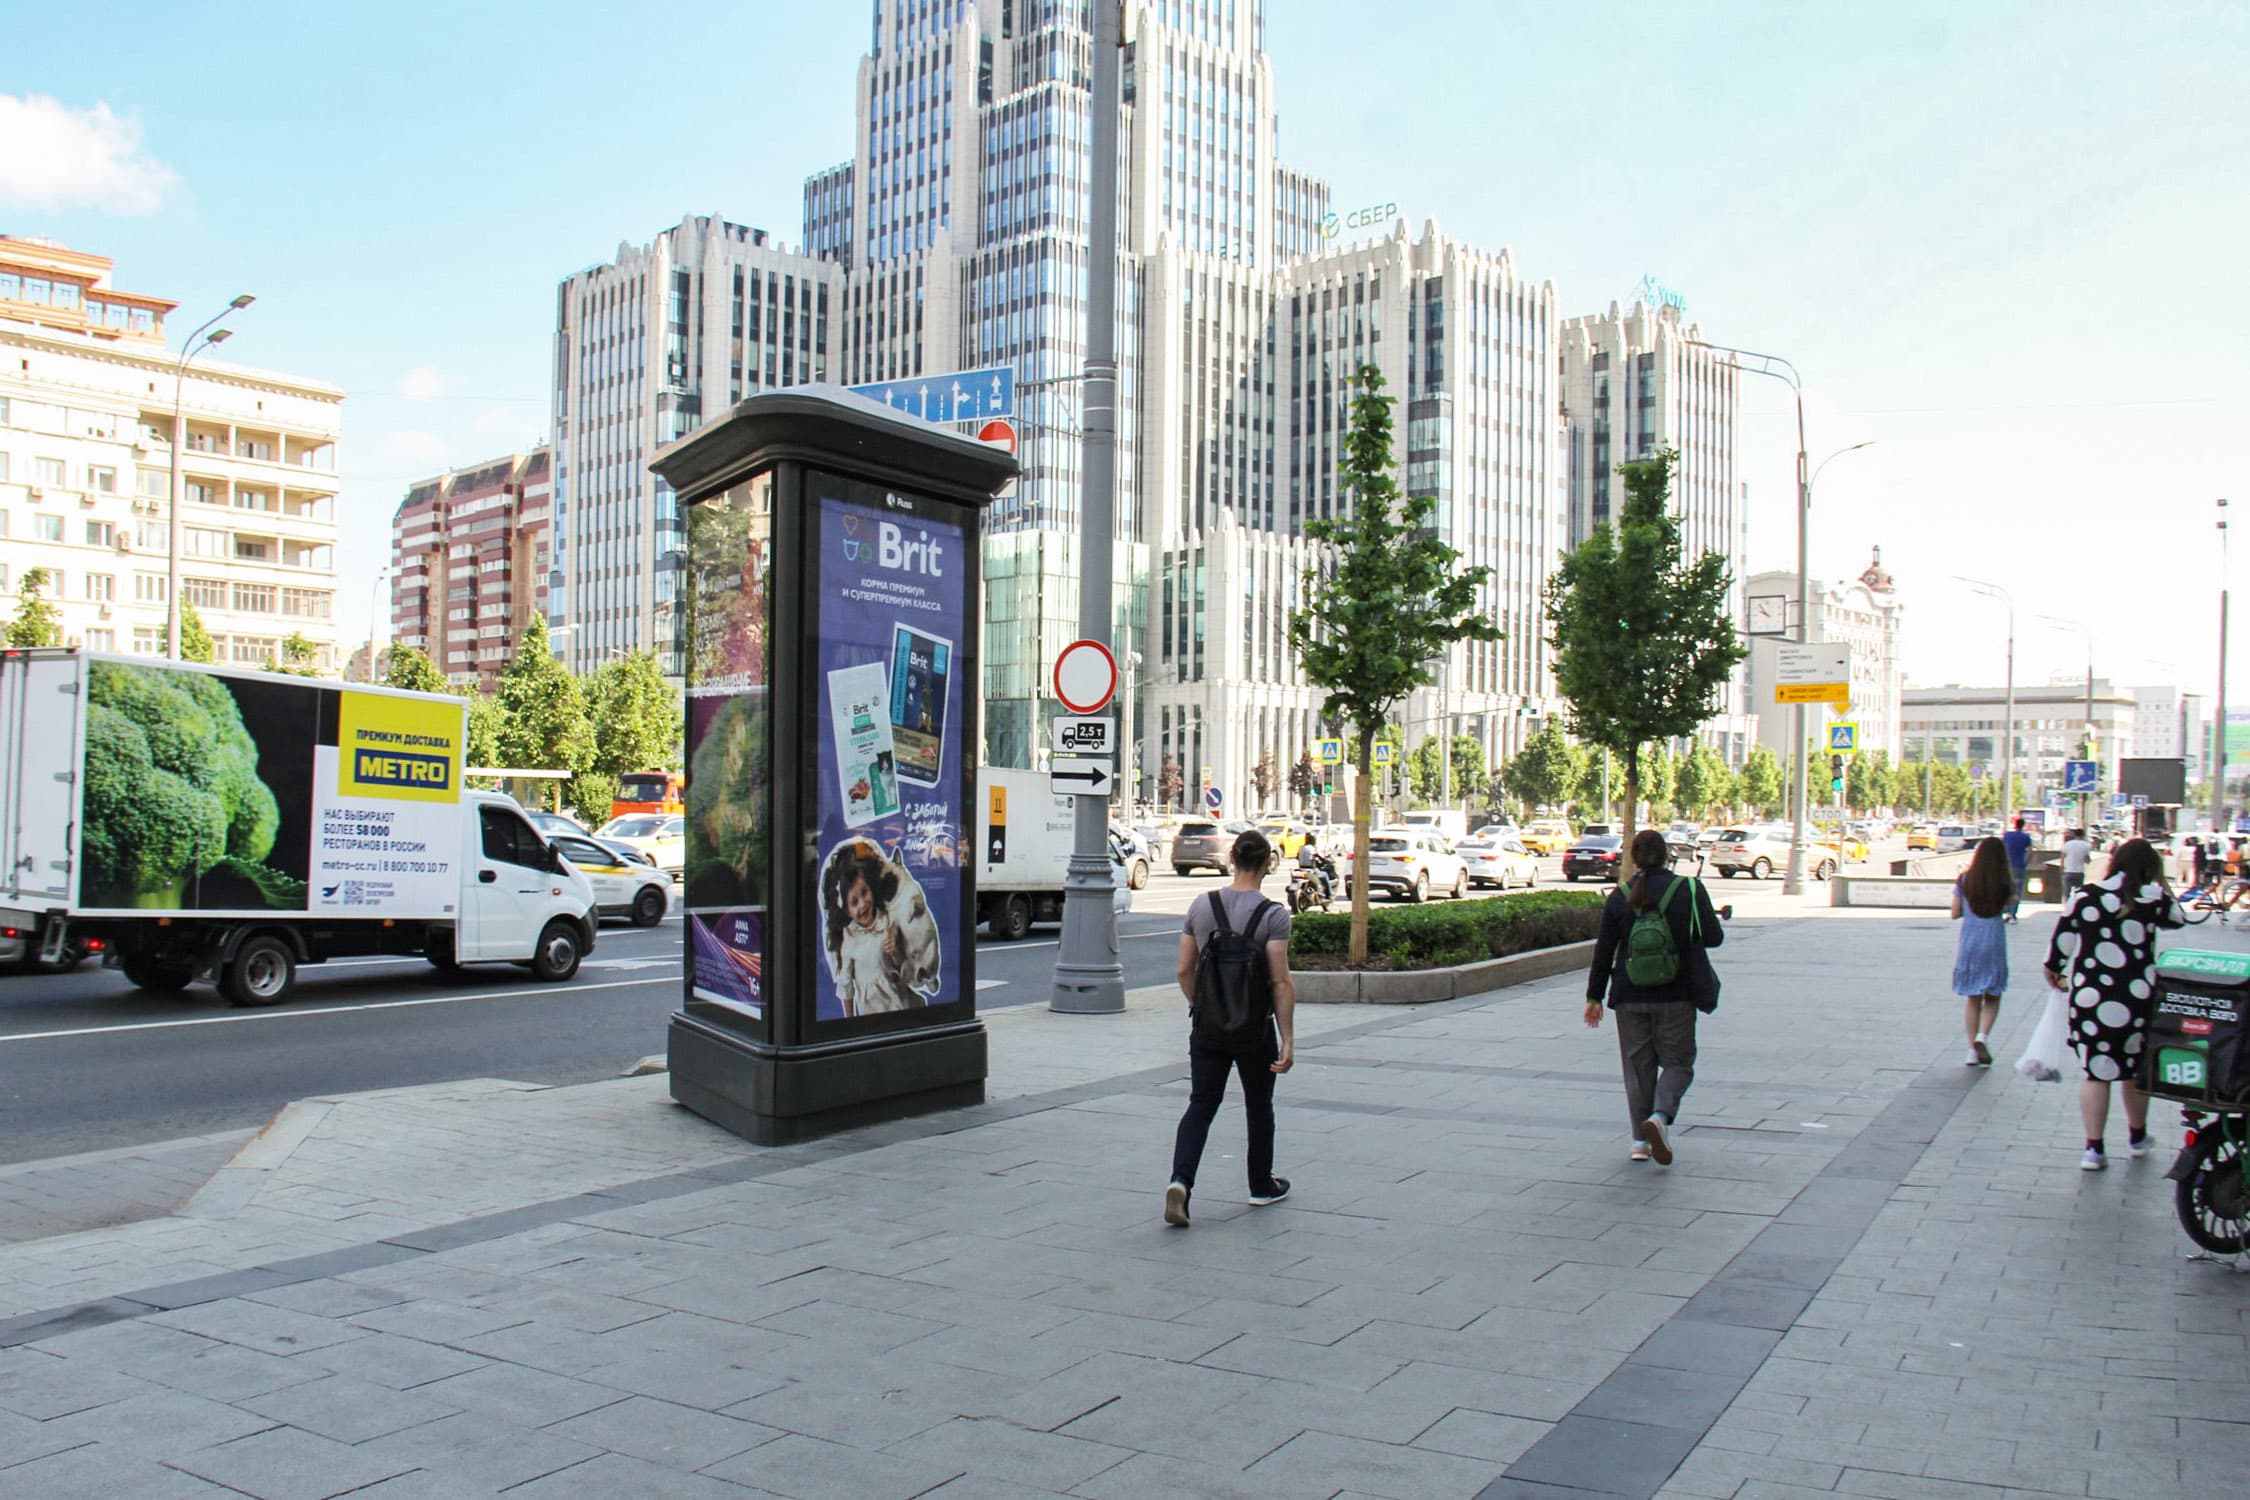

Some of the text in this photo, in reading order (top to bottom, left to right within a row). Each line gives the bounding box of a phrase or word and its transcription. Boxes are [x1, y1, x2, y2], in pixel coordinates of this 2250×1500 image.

[1346, 202, 1398, 229] СБЕР
[879, 521, 943, 577] Brit
[860, 578, 925, 596] КОРМА ПРЕМИУМ
[842, 588, 942, 611] И СУПЕРПРЕМИУМ КЛАССА
[909, 651, 929, 670] Brit
[853, 704, 869, 716] Brit
[357, 729, 450, 748] ПРЕМИУМ ДОСТАВКА
[1079, 726, 1095, 738] 2,5
[360, 756, 445, 782] METRO
[324, 809, 395, 822] НАС ВЫБИРАЮТ
[1813, 809, 1842, 820] СТОП
[324, 823, 390, 837] БОЛЕЕ 58 000
[323, 838, 426, 853] РЕСТОРАНОВ В РОССИИ
[322, 861, 448, 873] metro-cc.ru 8 800 700 10 77
[735, 919, 749, 932] ANNA
[748, 976, 760, 996] 16+
